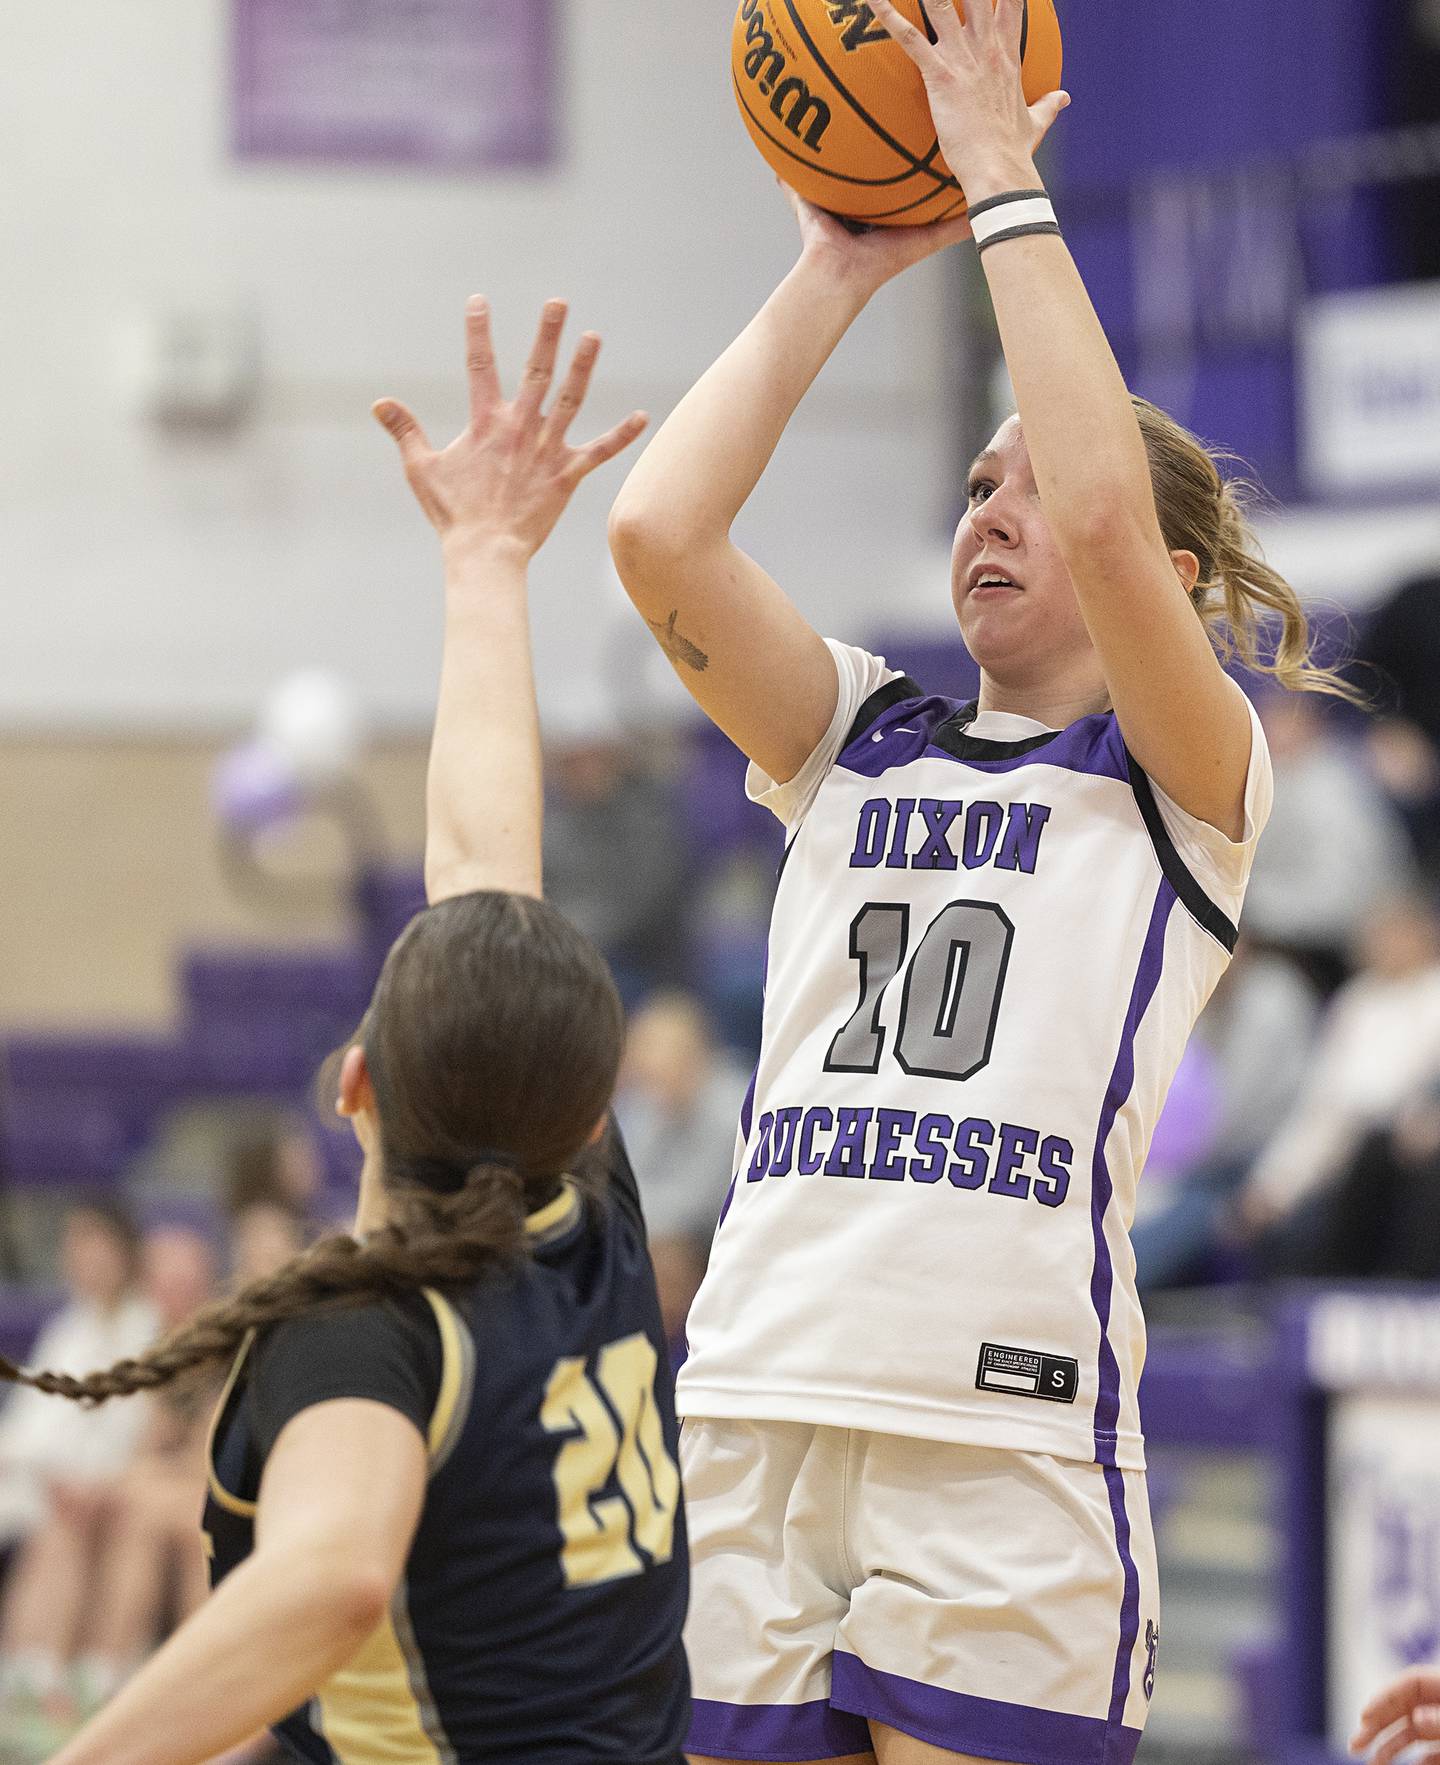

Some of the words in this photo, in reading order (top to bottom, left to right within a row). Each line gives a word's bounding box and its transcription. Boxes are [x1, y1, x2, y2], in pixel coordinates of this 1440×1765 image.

[741, 0, 832, 153] Wilso
[849, 798, 1051, 874] DIXON
[822, 899, 1016, 1082] 10
[747, 1106, 1074, 1208] DUCHESSES
[987, 1350, 1039, 1365] ENGINEERED
[1051, 1370, 1065, 1388] S
[540, 1331, 681, 1590] 20
